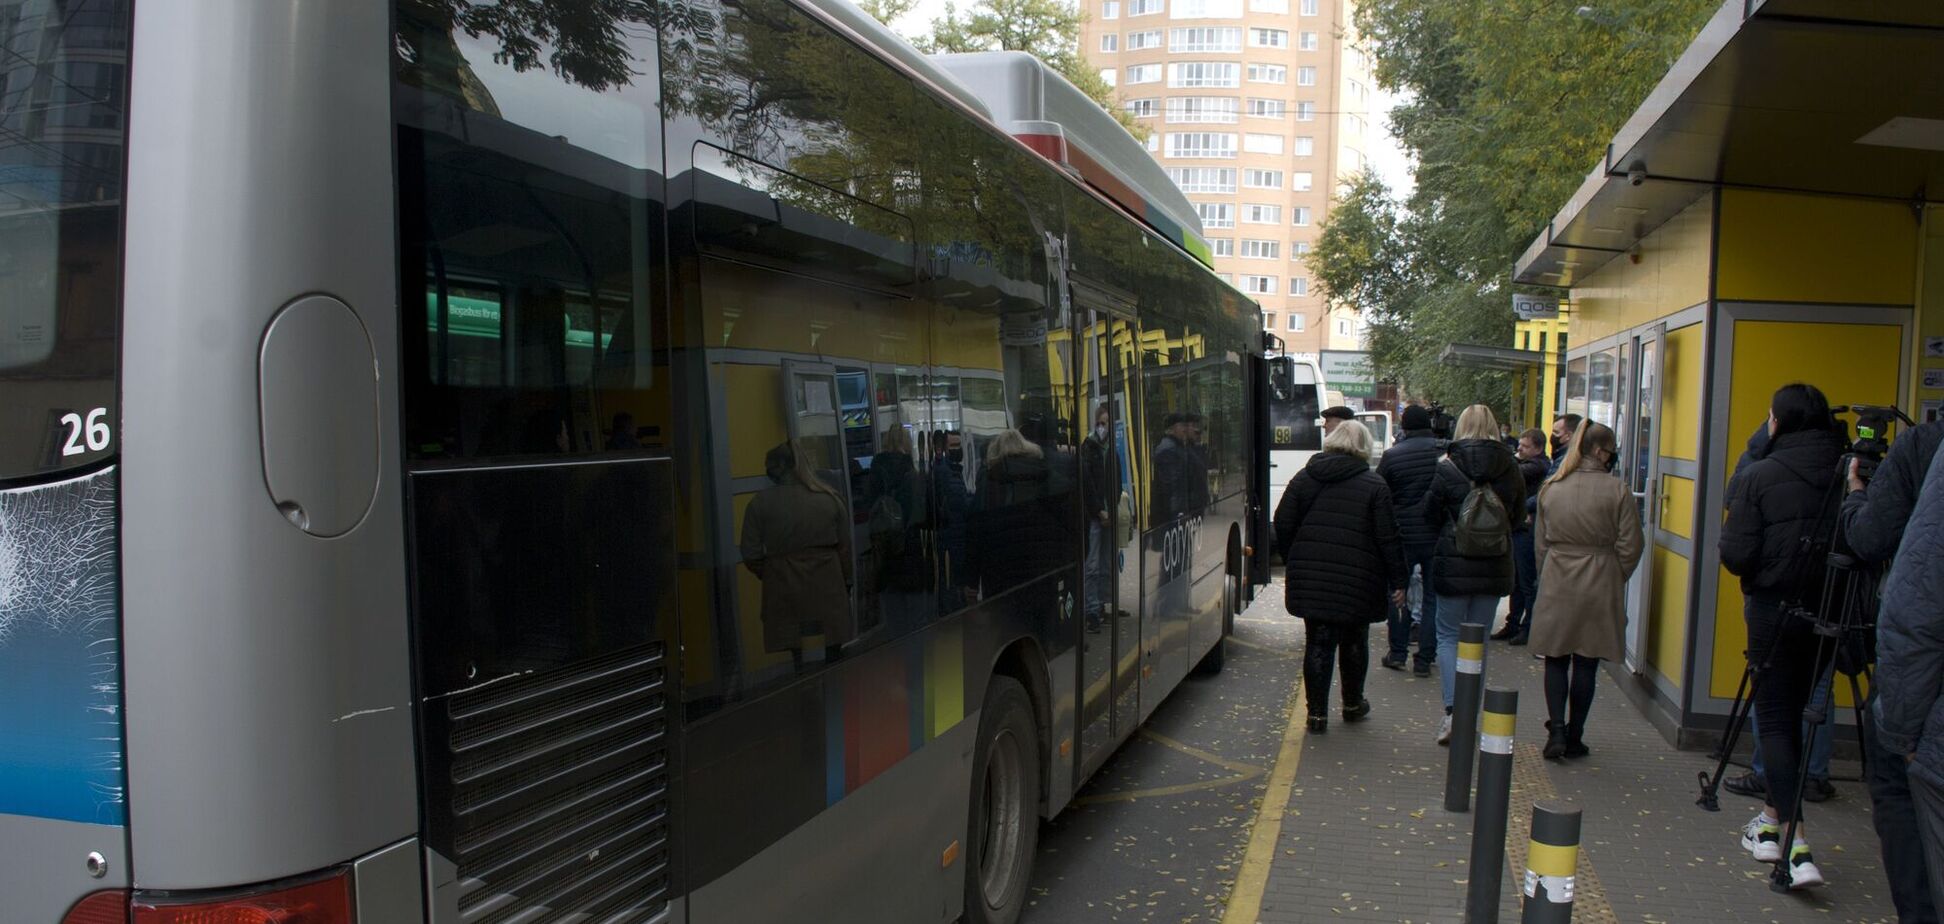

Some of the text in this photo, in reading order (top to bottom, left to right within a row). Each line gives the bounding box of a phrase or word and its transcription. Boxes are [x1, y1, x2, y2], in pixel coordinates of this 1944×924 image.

[1516, 302, 1556, 312] IQOS
[60, 407, 111, 456] 26
[1275, 428, 1290, 443] 98
